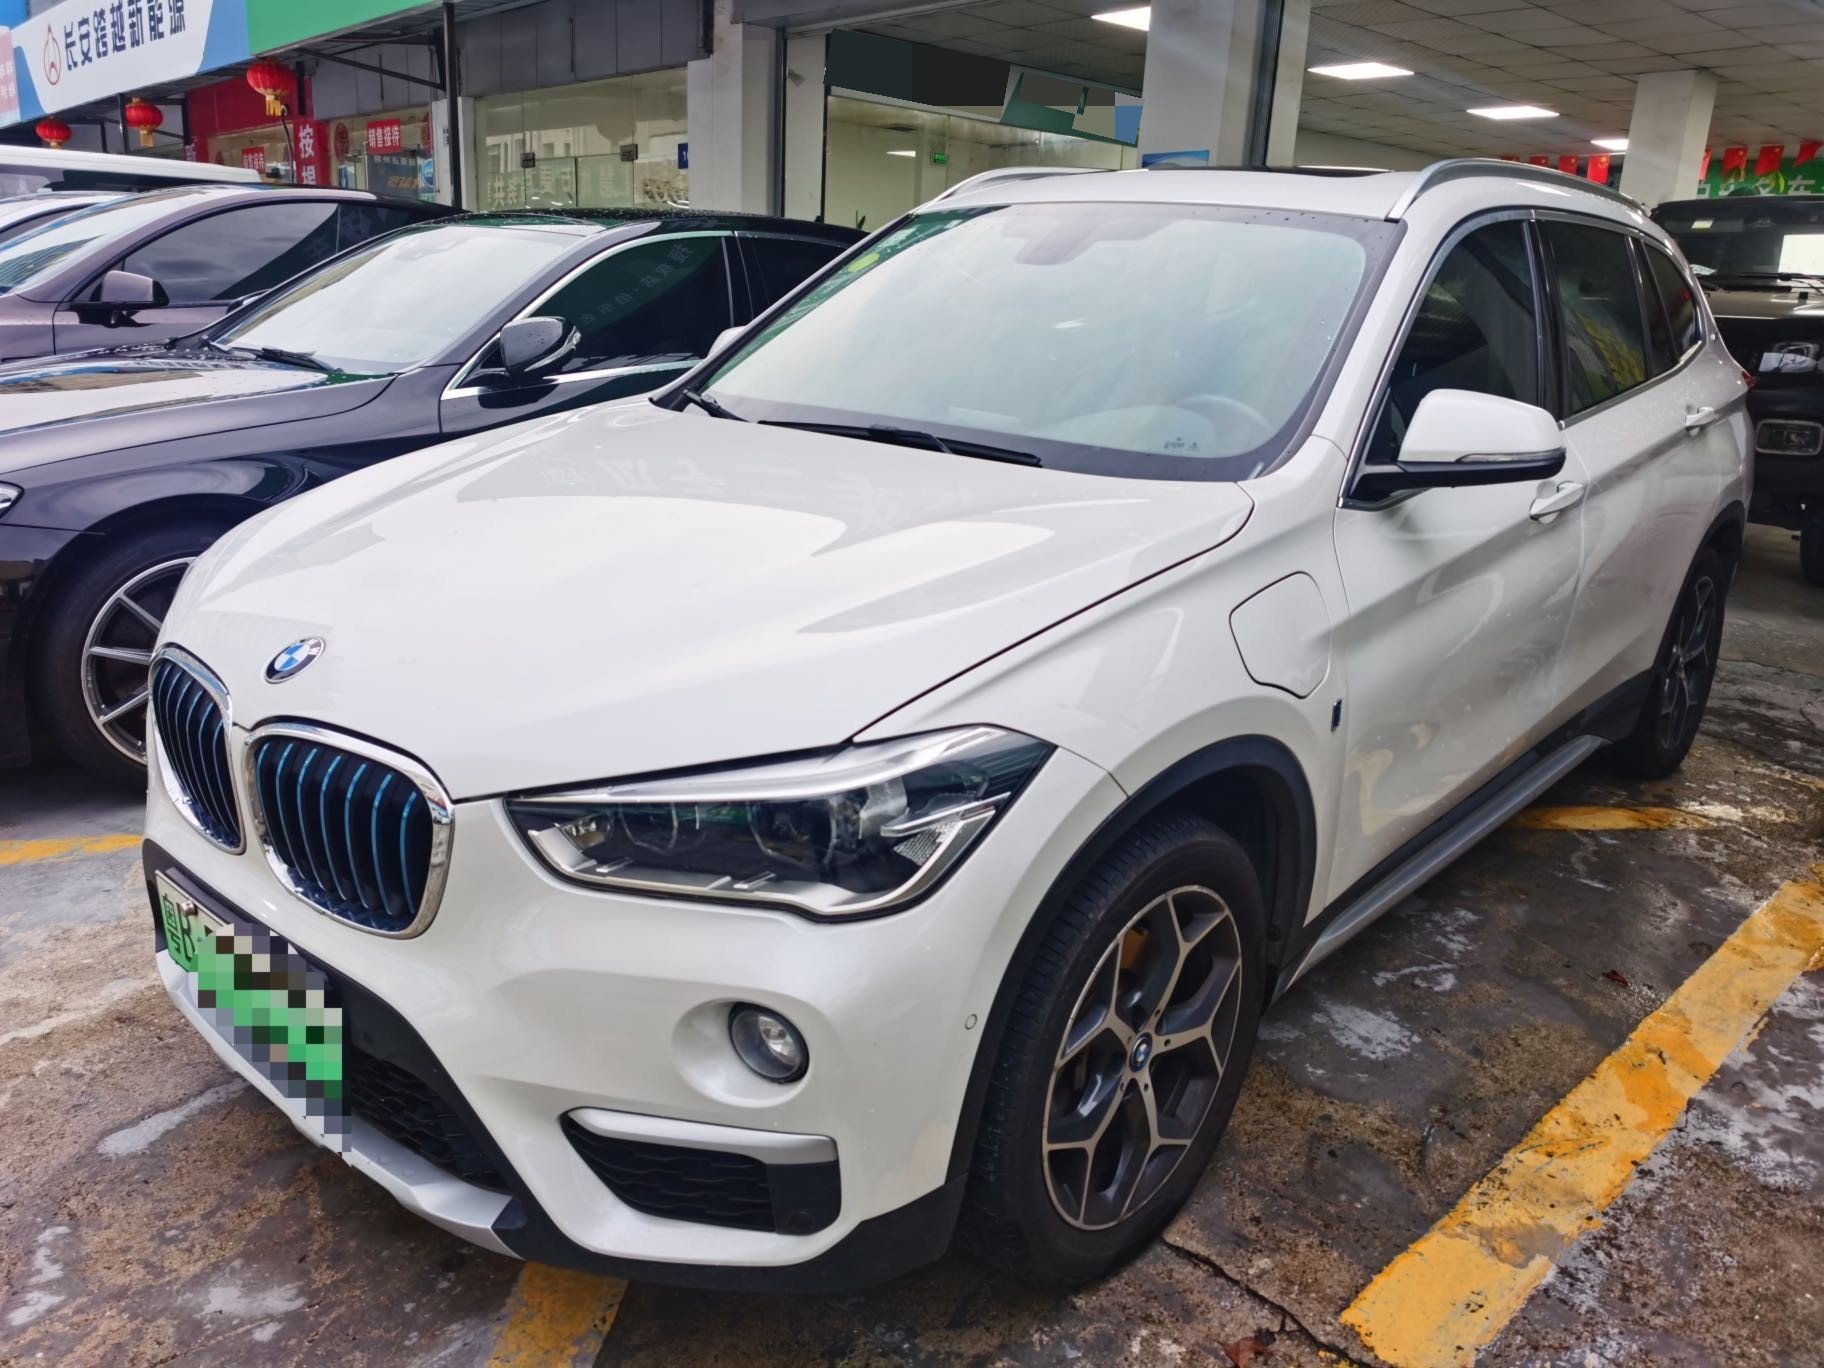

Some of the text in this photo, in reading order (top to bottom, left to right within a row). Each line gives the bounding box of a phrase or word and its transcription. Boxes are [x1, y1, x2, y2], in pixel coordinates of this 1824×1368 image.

[64, 0, 186, 71] 长安跨越新能源
[368, 124, 400, 148] 销售接待
